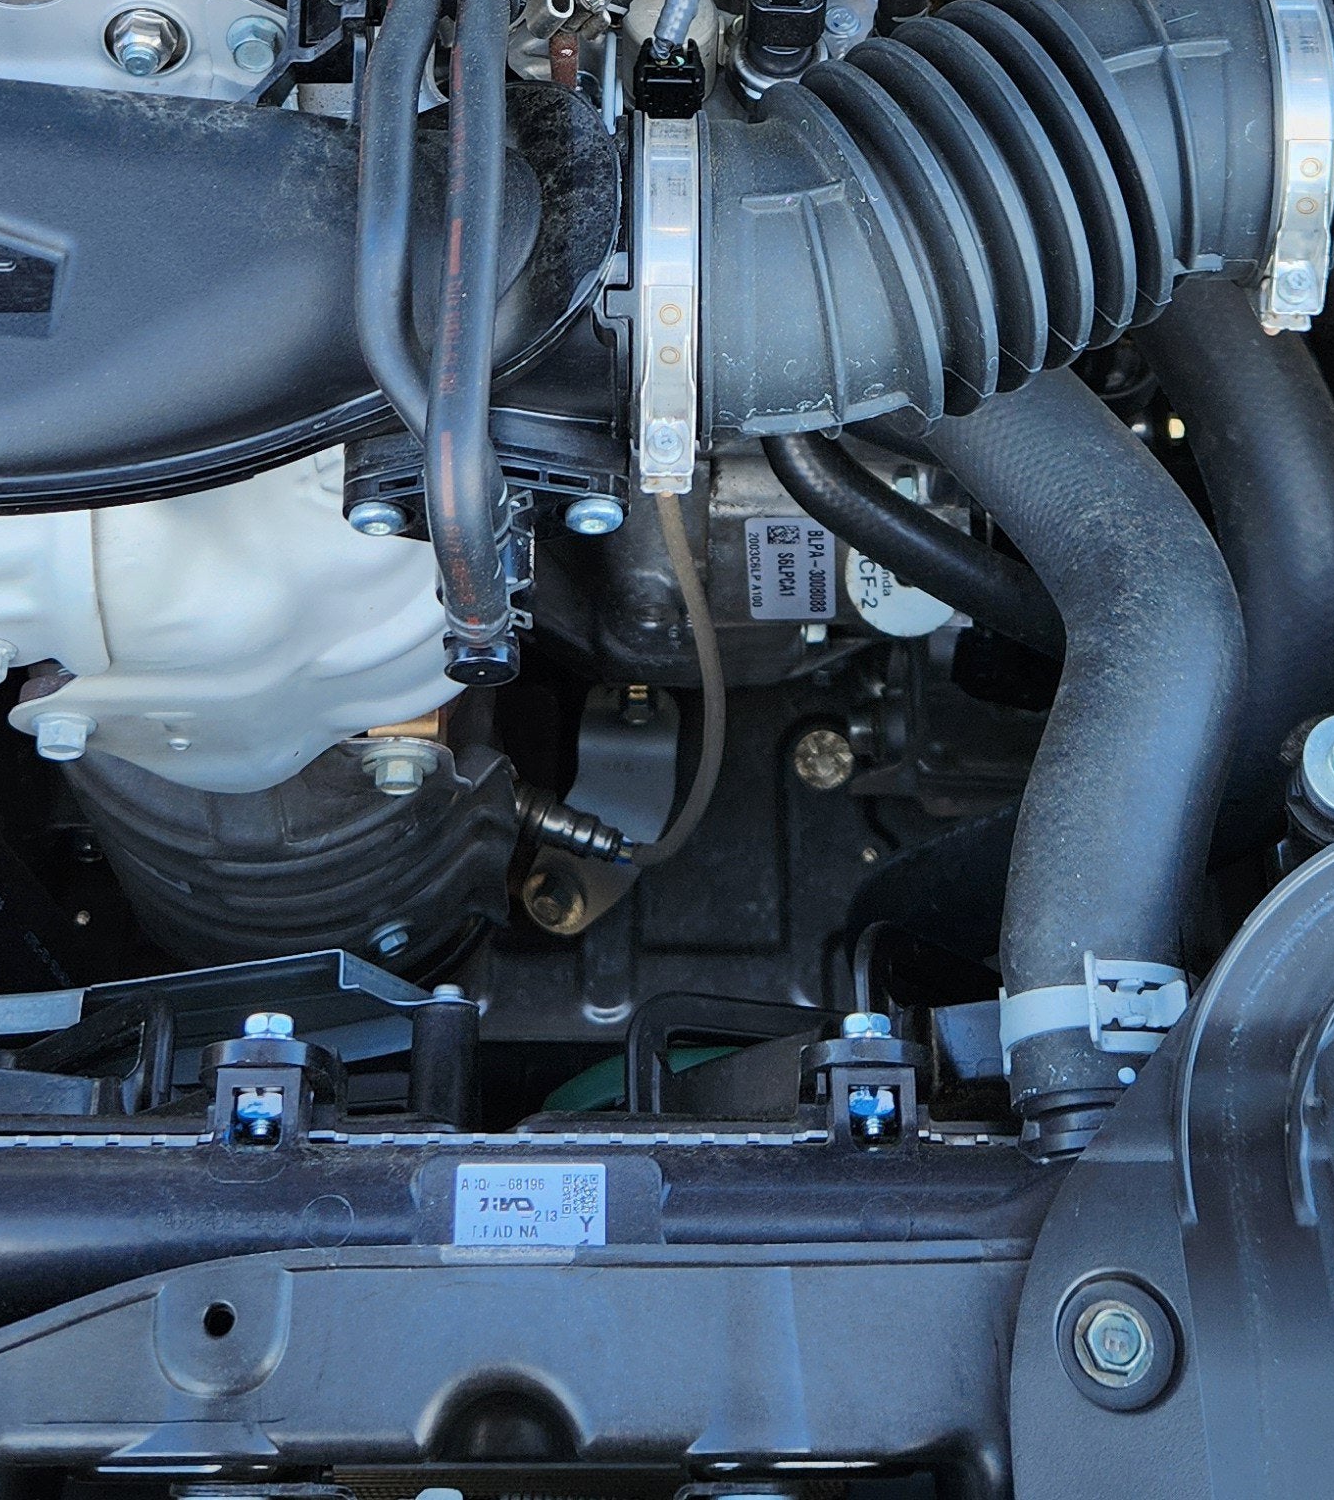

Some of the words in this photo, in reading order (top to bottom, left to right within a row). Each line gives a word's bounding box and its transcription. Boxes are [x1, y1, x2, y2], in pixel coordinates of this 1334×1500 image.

[777, 552, 796, 597] S6LPCA1
[881, 568, 894, 597] nda
[752, 583, 763, 608] A100
[519, 1225, 539, 1238] NA
[580, 1215, 595, 1233] Y
